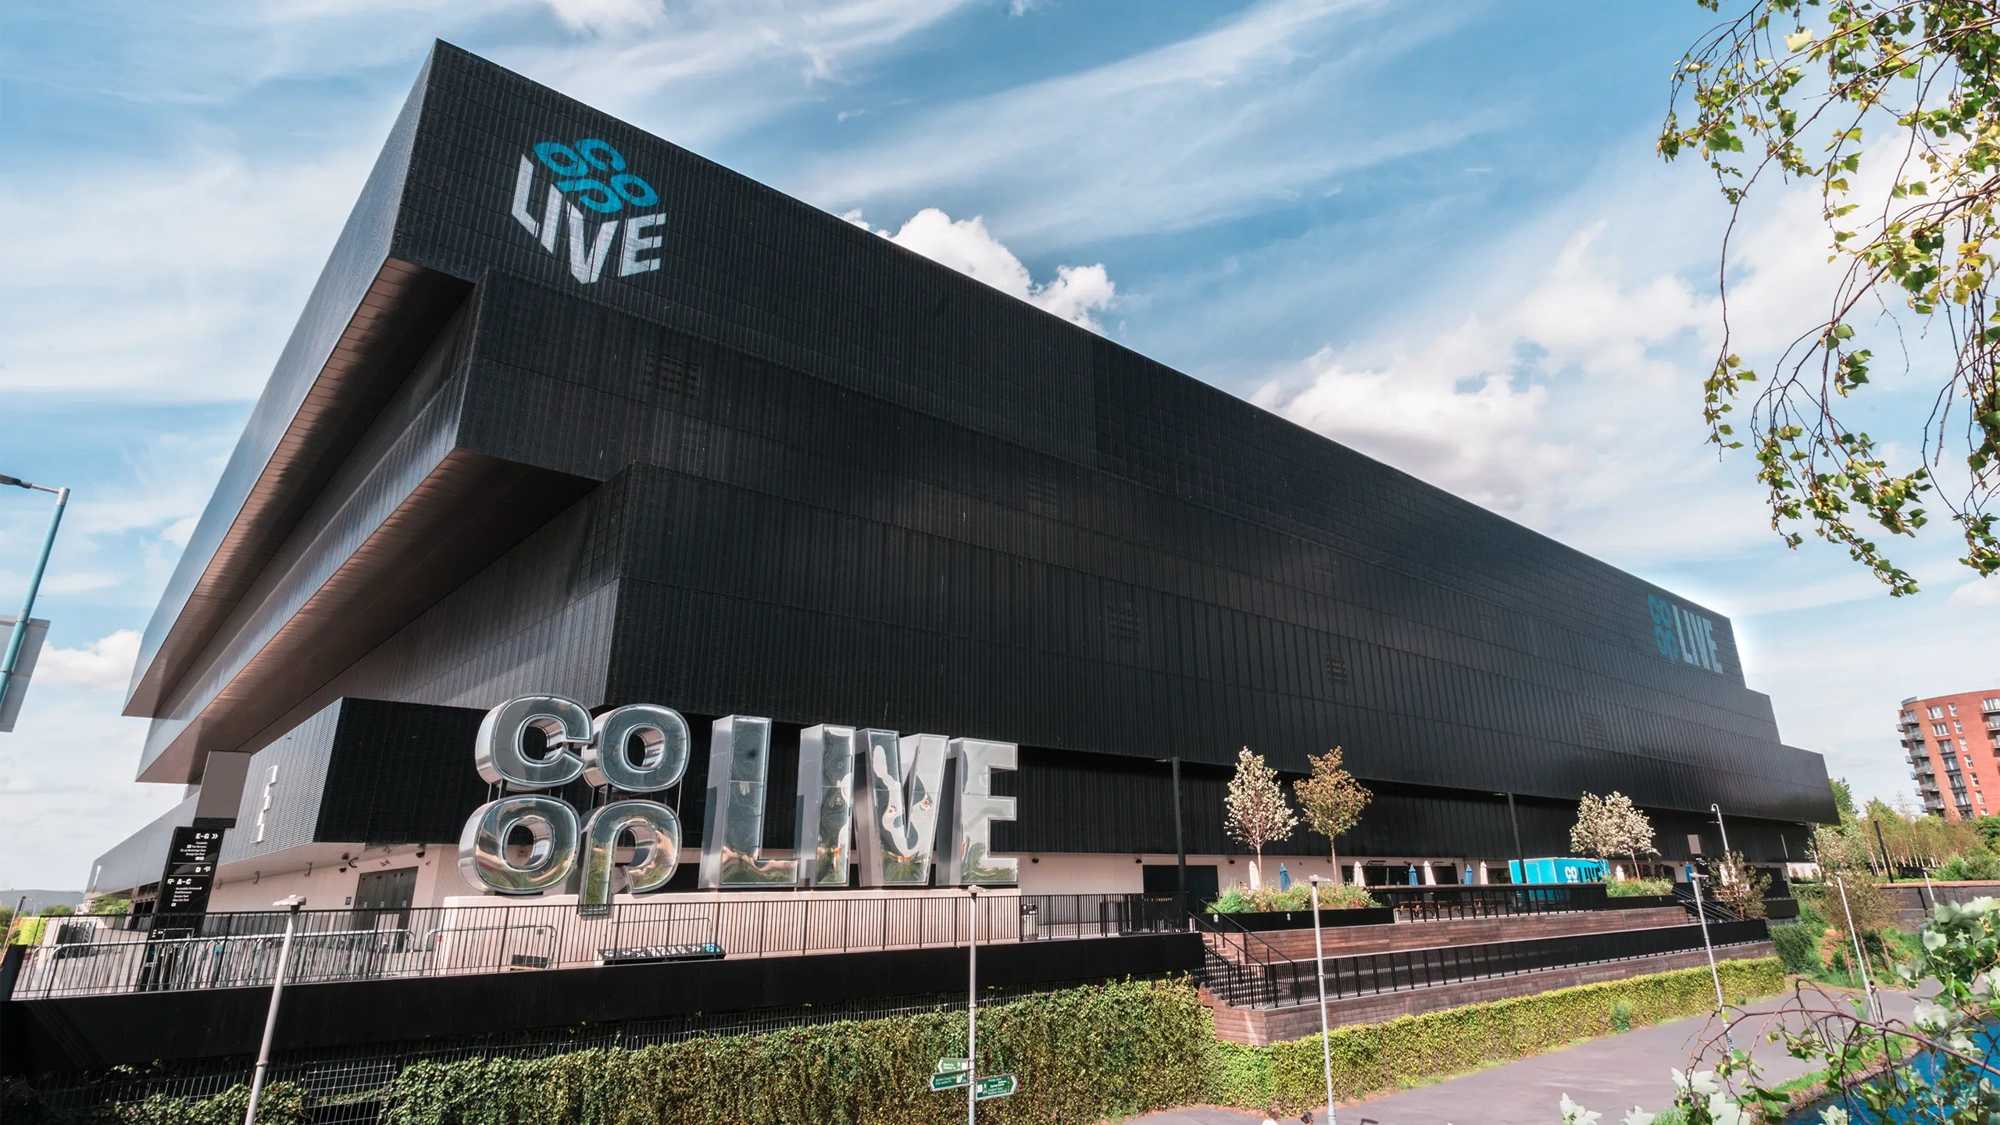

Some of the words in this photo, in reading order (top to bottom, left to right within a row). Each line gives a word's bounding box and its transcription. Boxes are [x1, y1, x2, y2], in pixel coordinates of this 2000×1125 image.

[511, 154, 667, 285] LIVE
[1672, 604, 1723, 674] LIVE
[698, 714, 1019, 889] LIVE
